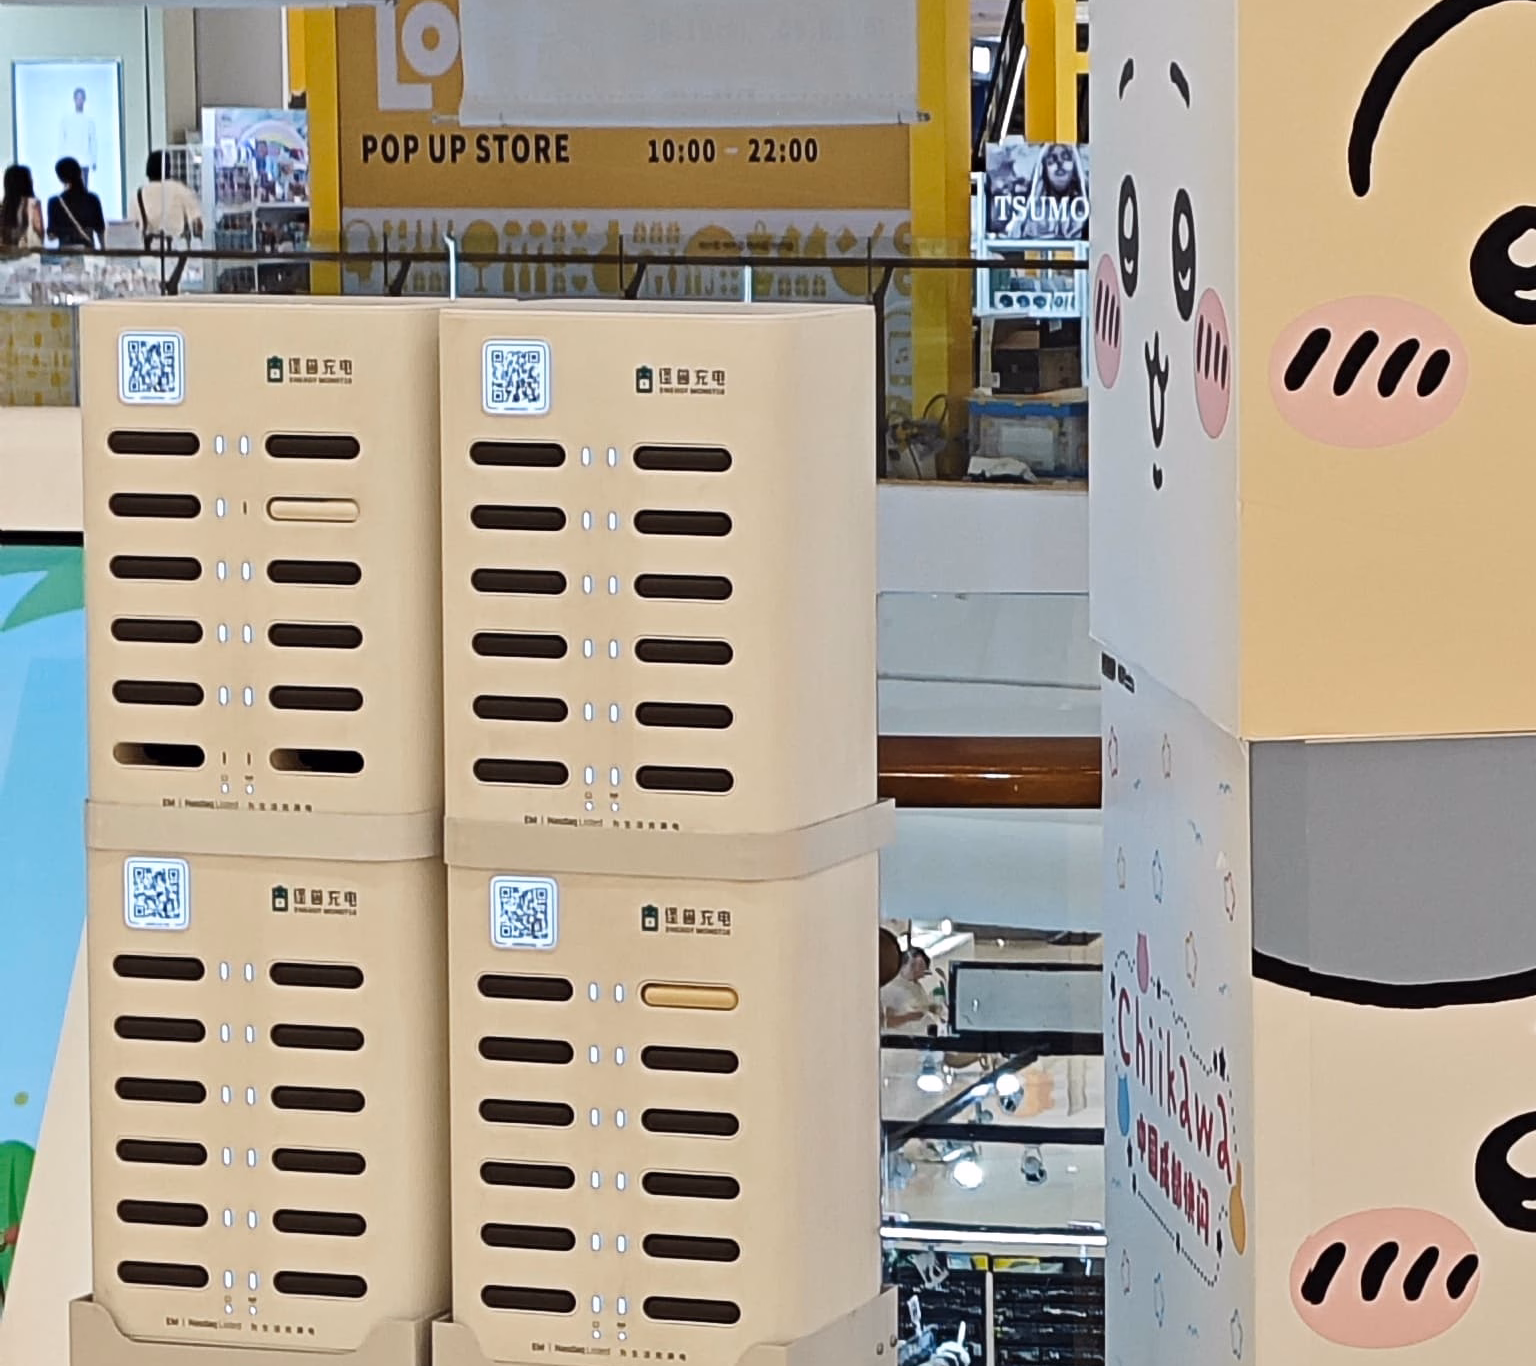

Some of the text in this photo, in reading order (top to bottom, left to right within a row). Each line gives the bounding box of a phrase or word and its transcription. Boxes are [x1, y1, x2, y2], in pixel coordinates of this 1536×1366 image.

[362, 133, 419, 164] POP
[428, 134, 467, 163] UP
[475, 133, 570, 164] STORE
[647, 138, 716, 163] 10:00
[747, 137, 819, 163] 22:00
[1118, 986, 1233, 1185] Chiikawa
